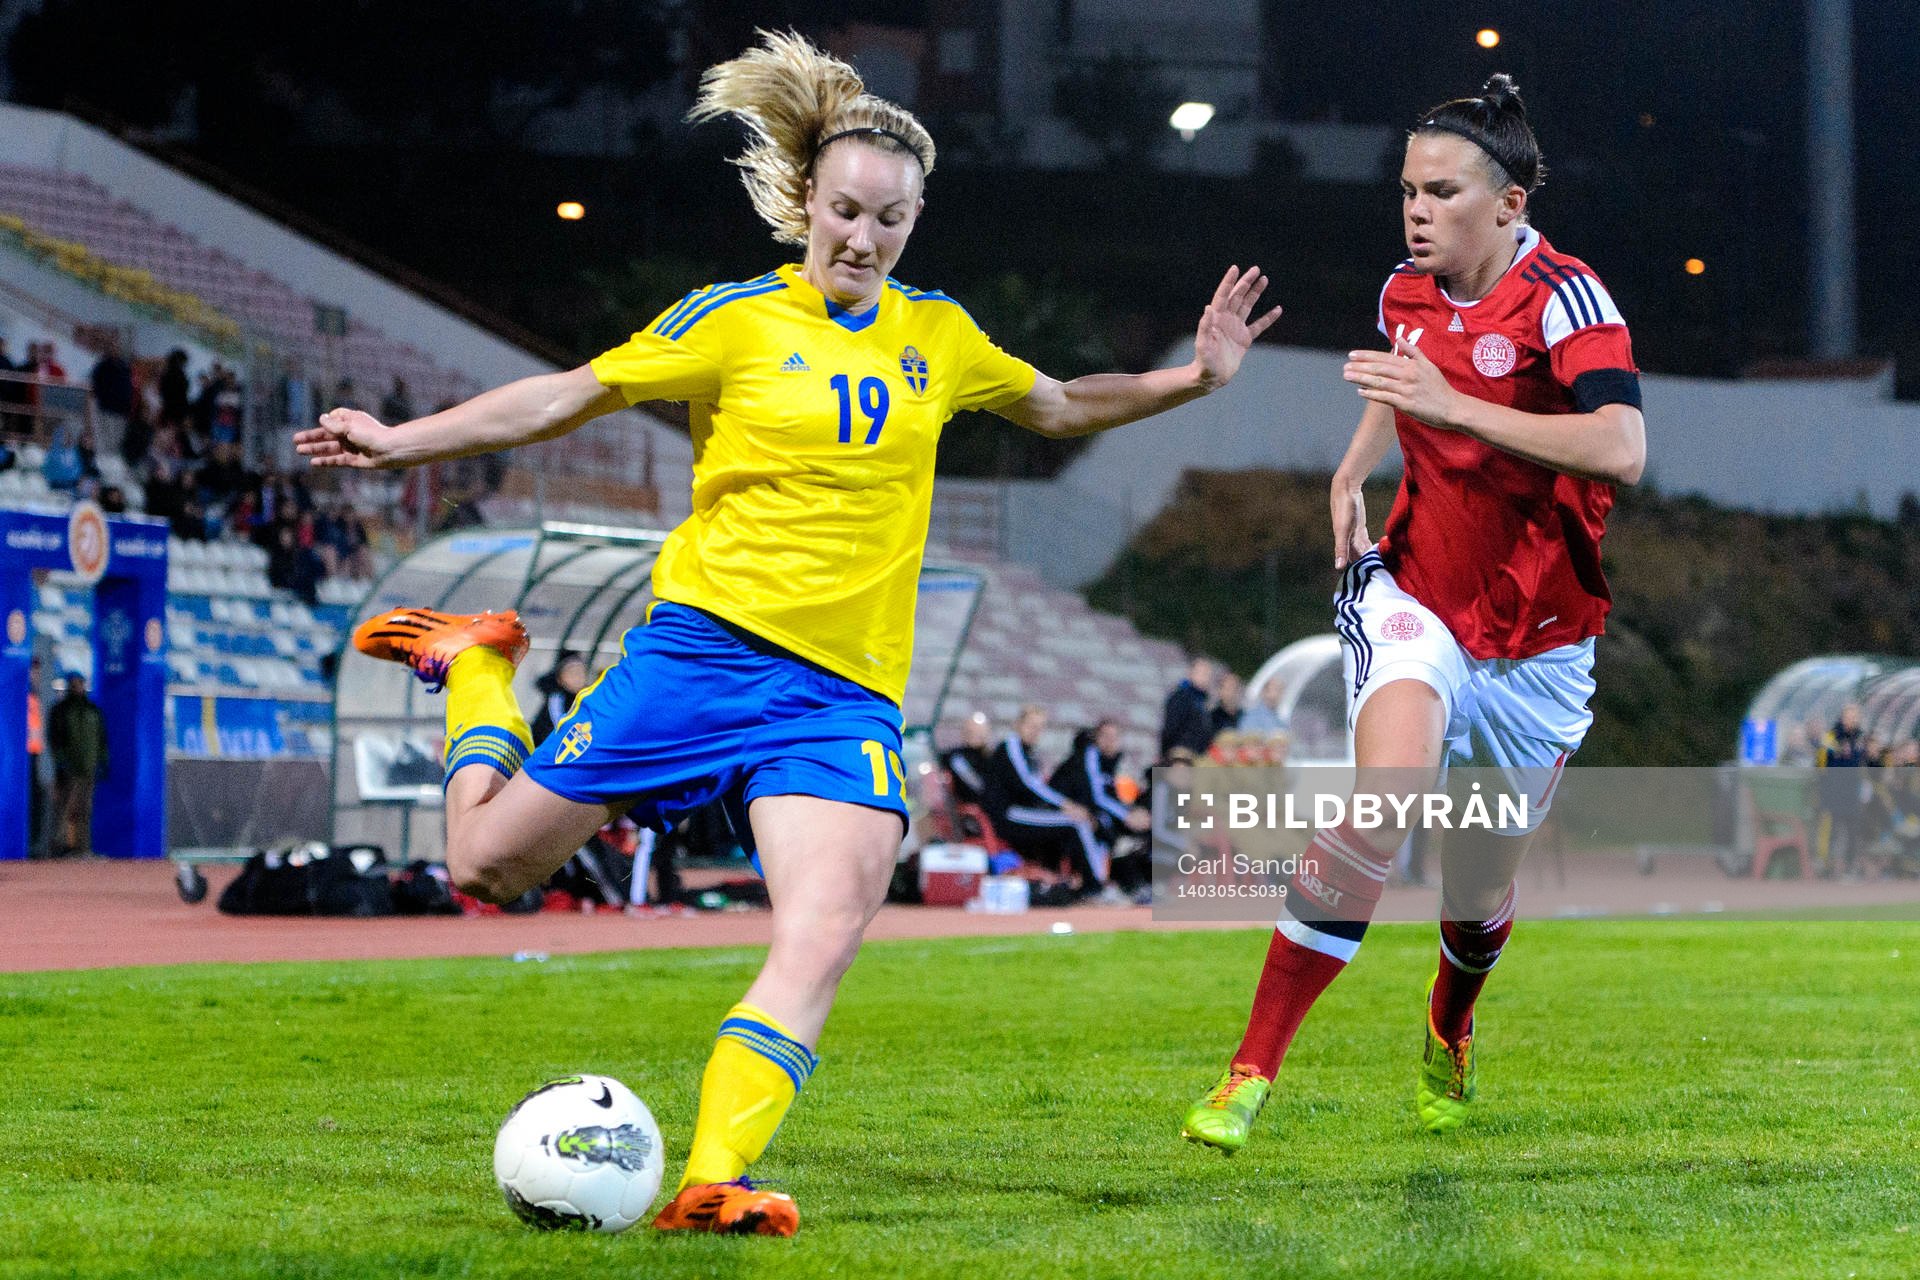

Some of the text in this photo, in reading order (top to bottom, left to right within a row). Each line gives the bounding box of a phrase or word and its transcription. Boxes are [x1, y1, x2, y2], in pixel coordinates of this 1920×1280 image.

[1482, 347, 1507, 361] DBU
[780, 363, 811, 372] adidas
[830, 374, 890, 444] 19
[1391, 622, 1414, 632] DBU
